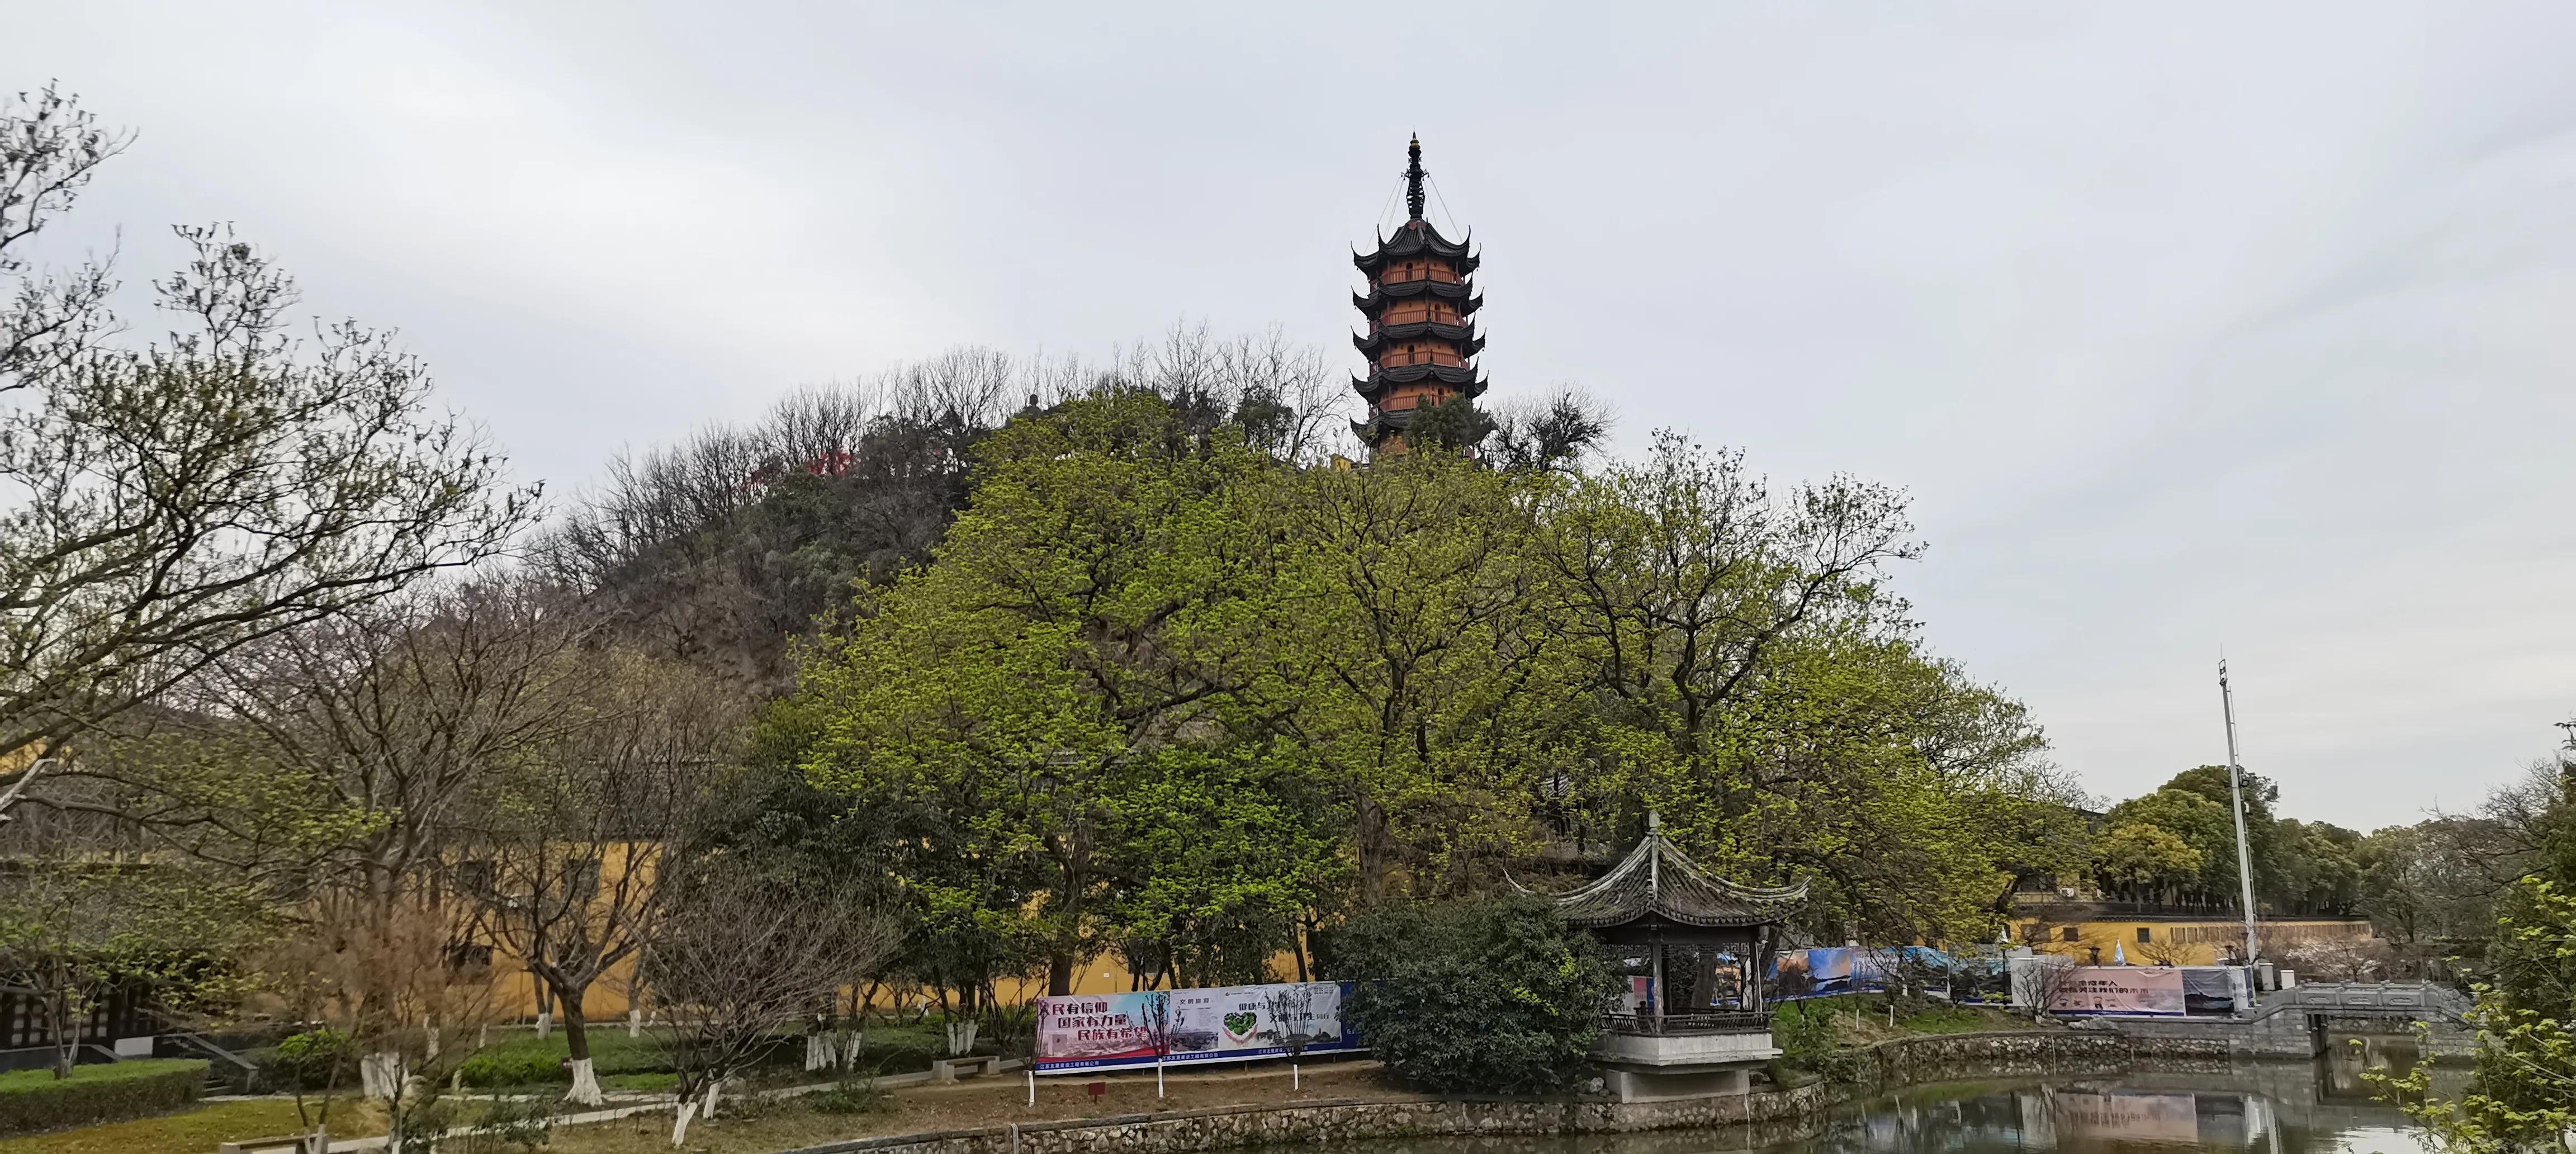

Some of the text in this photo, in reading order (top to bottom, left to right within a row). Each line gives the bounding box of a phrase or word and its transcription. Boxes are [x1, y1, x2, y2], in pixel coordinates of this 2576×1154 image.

[1039, 1001, 1107, 1015] 人民有信仰
[1058, 1014, 1126, 1028] 国家有力量
[1078, 1027, 1148, 1041] 民族有希望
